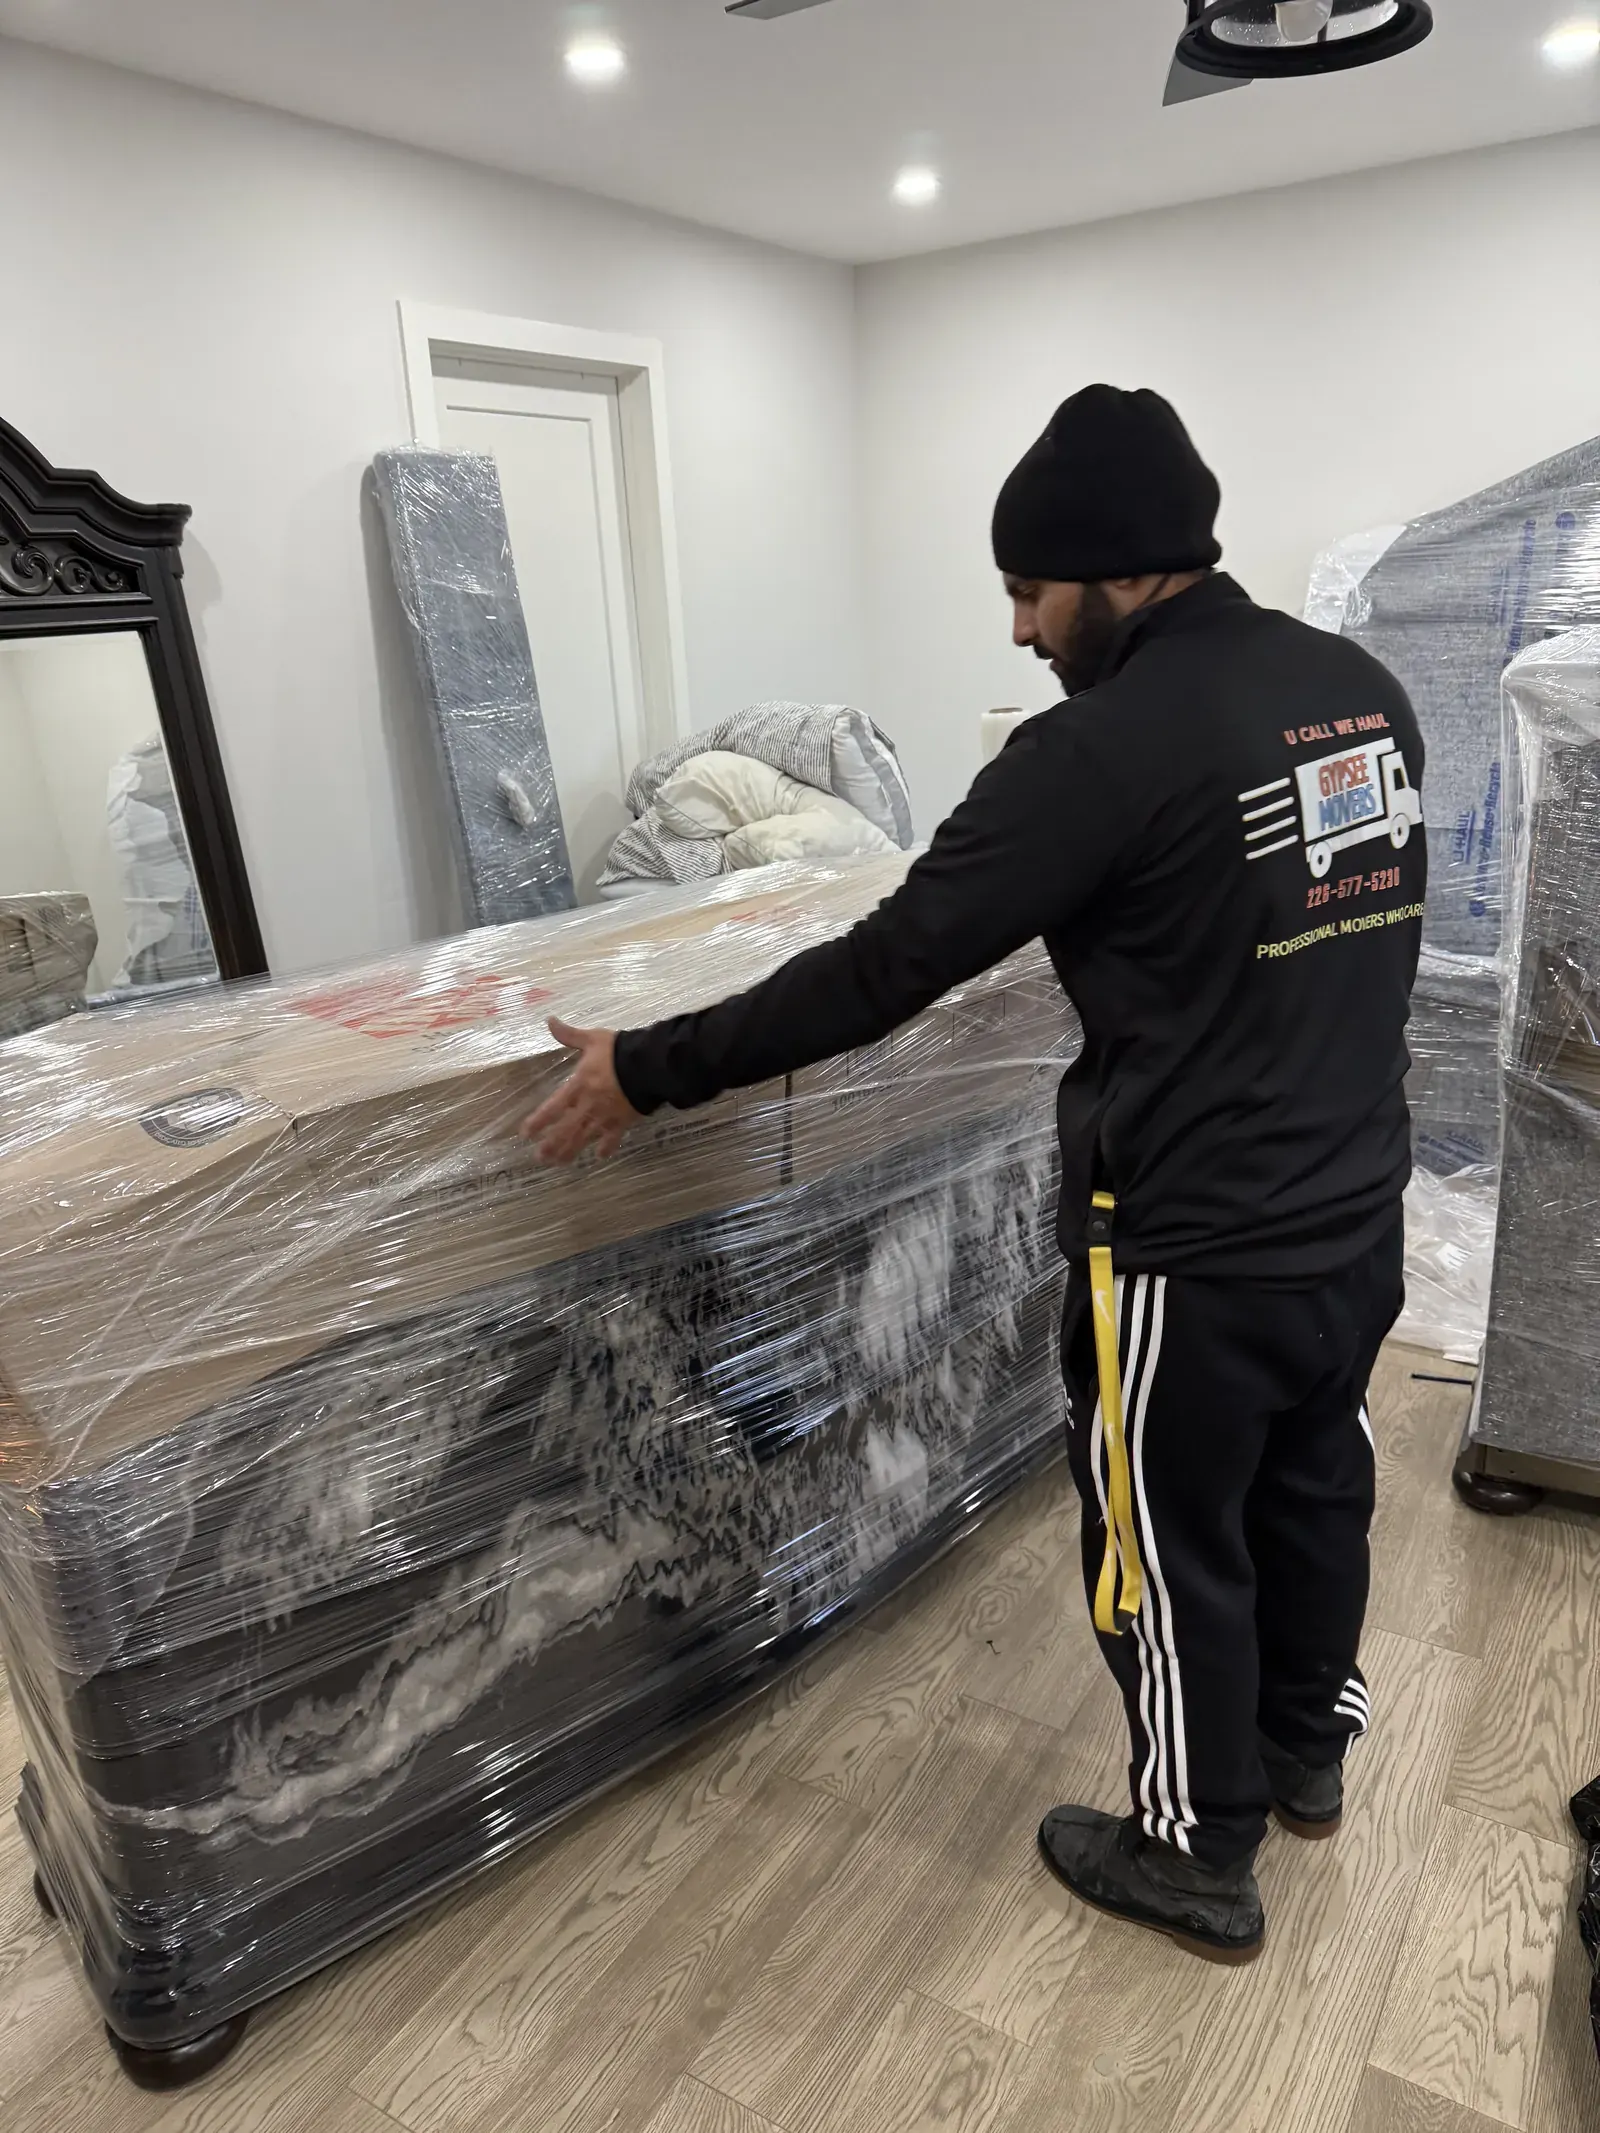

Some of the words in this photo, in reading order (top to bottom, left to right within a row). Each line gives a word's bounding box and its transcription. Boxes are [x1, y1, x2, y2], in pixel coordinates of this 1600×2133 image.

[1284, 730, 1298, 745] U
[1299, 723, 1335, 742] CALL
[1333, 718, 1356, 736] WE
[1355, 713, 1390, 732] HAUL
[1319, 752, 1369, 797] GYPSEE
[1318, 783, 1377, 831] MOVERS
[1453, 811, 1470, 863] U-HAUL
[1306, 866, 1400, 909] 226-577-5230
[1256, 922, 1339, 959] PROFESSIONAL
